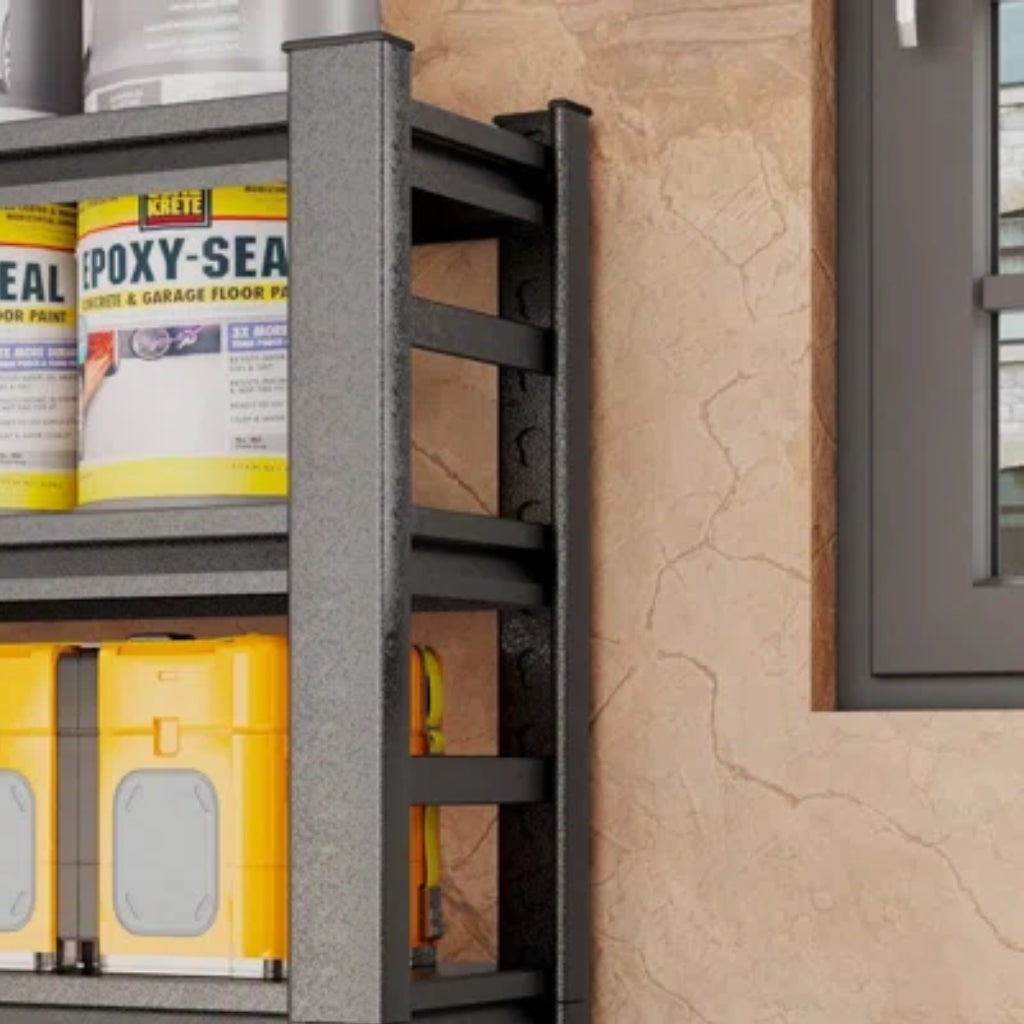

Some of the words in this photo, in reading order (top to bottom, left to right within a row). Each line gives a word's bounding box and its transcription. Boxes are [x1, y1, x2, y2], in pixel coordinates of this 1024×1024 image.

[83, 236, 288, 290] EPOXY-SEA
[143, 288, 205, 305] GARAGE
[212, 286, 264, 301] FLOOR
[30, 309, 67, 324] PAINT
